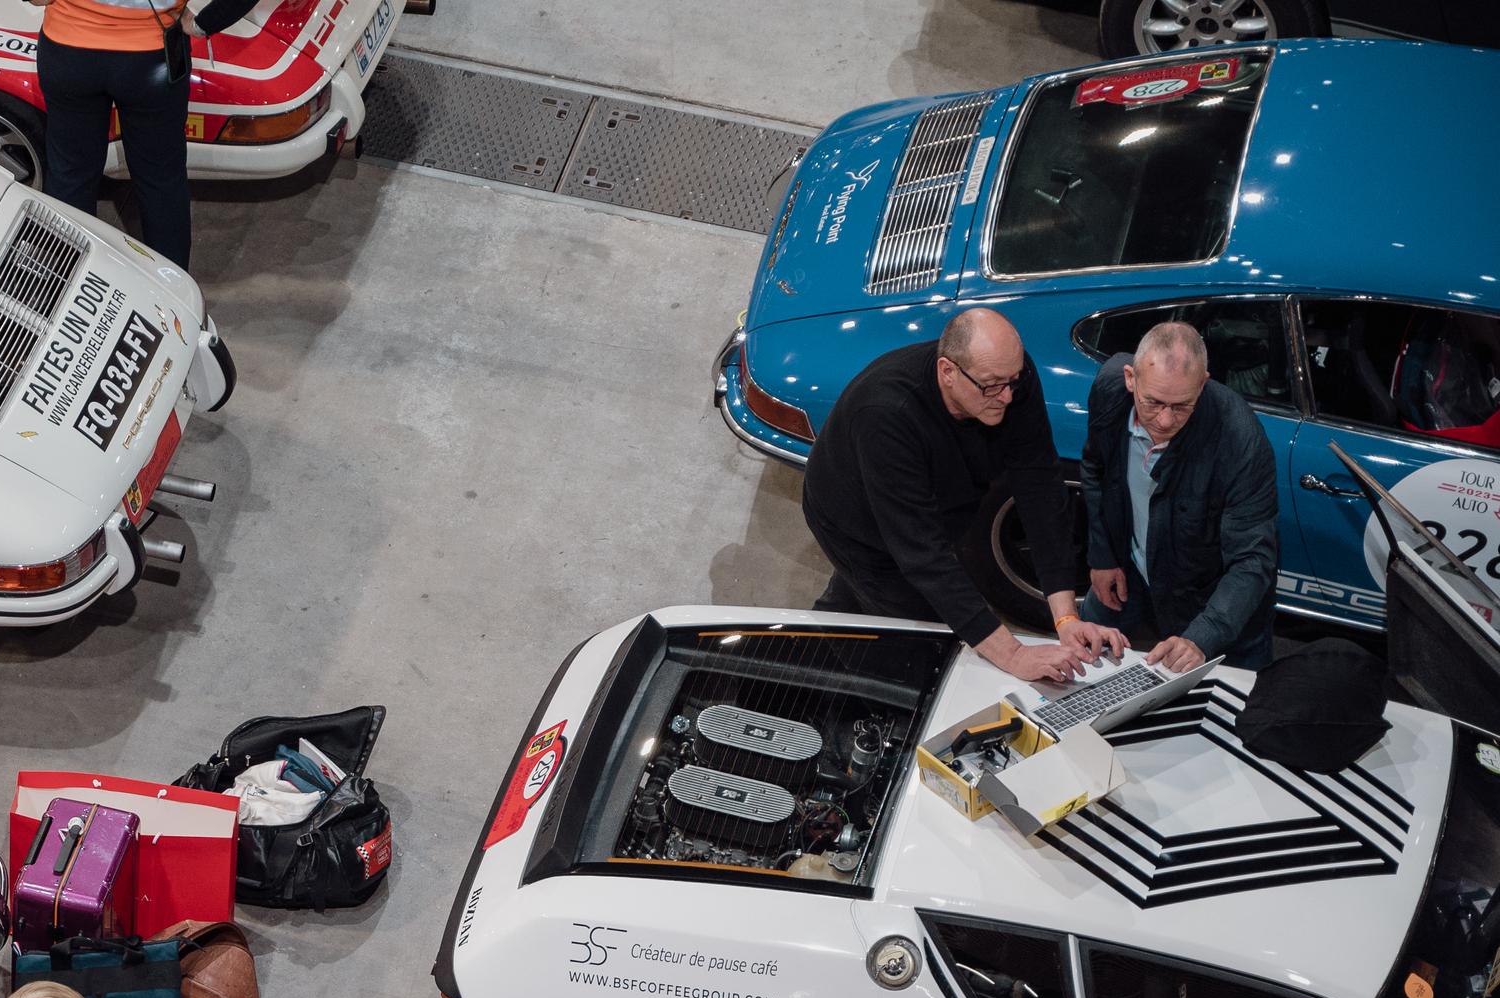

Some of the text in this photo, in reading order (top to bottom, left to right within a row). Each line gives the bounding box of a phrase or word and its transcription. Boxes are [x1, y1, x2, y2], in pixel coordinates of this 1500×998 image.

[1133, 80, 1181, 97] 228
[825, 183, 857, 244] Flying Point
[21, 271, 111, 415] FAITES UN DON
[48, 288, 128, 427] WWW.CANCERDELENFANT.FR
[78, 314, 156, 445] FQ-034-FY
[1458, 486, 1491, 499] 2023
[1460, 470, 1495, 489] TOUR
[1452, 498, 1489, 514] AUTO
[529, 752, 554, 787] 297
[631, 943, 686, 965] Créateur
[689, 951, 705, 968] de
[707, 956, 747, 973] pause
[750, 959, 778, 977] café
